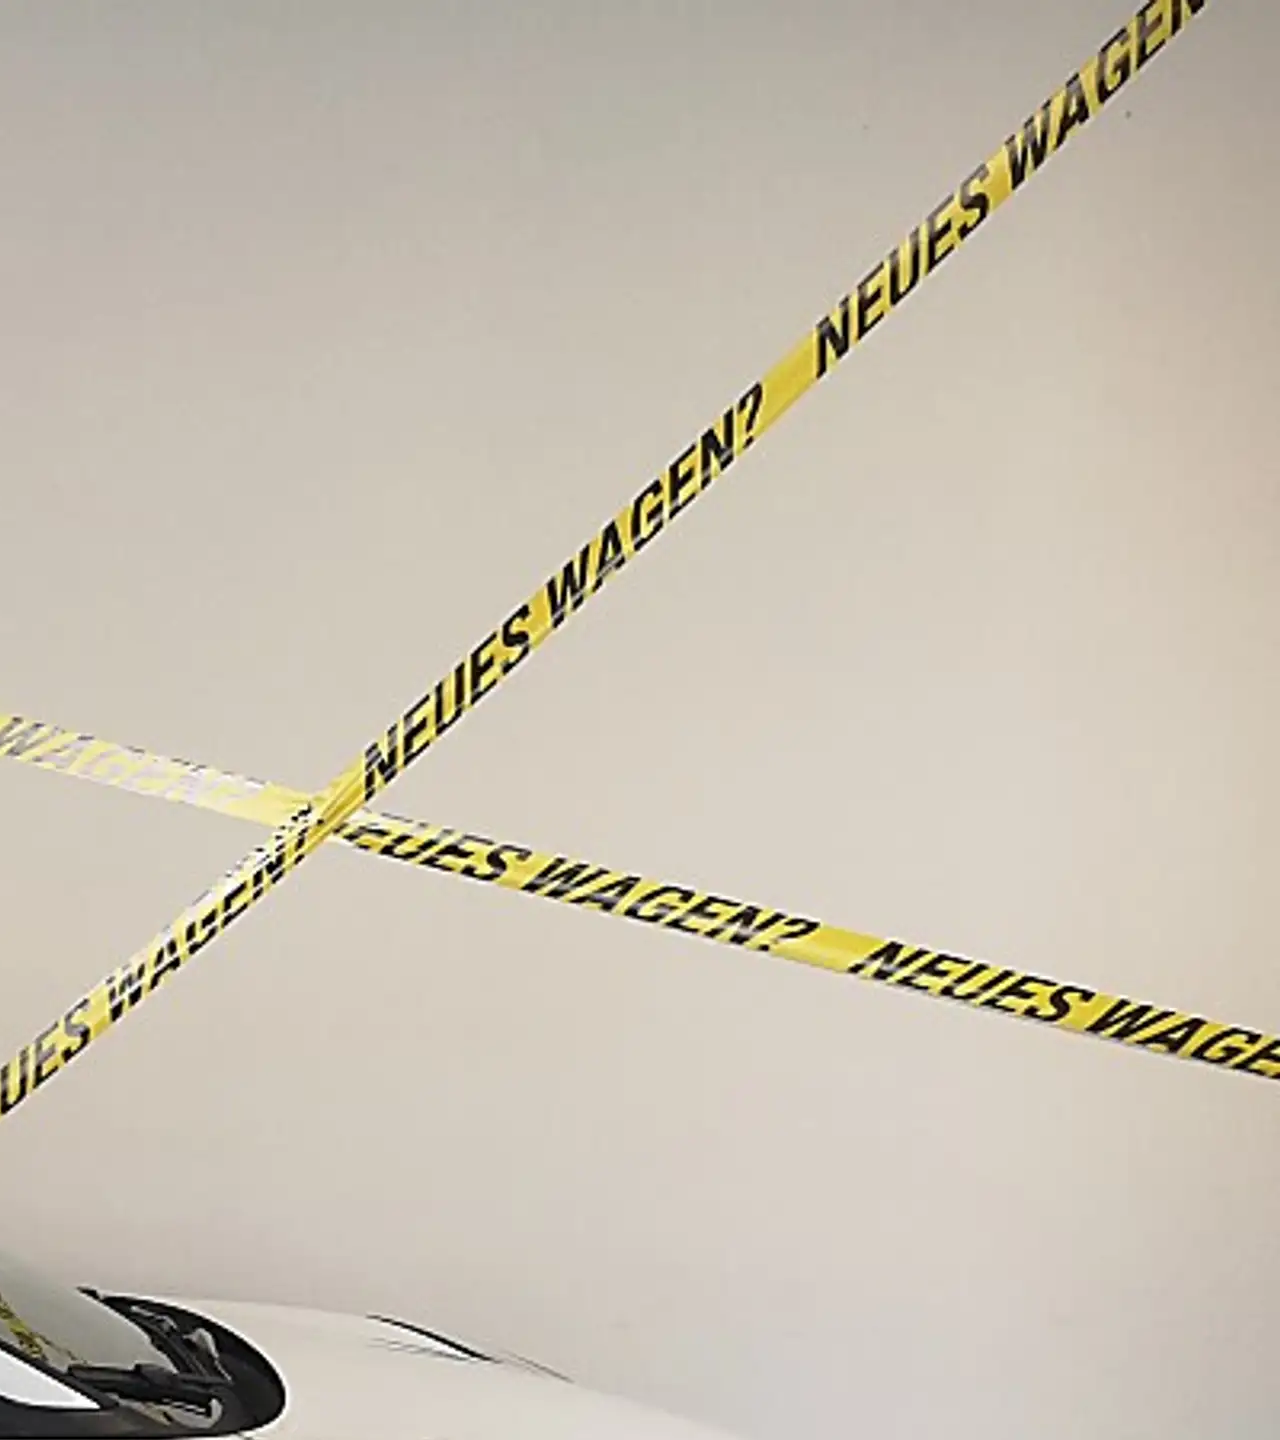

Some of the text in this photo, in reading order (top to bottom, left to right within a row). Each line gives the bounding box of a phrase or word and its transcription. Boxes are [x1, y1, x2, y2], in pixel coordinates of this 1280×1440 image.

[814, 165, 992, 378] NEUES
[362, 381, 764, 800] NEUES WAGEN?
[522, 856, 820, 950] WAGEN?
[848, 941, 1095, 1022] NEUES
